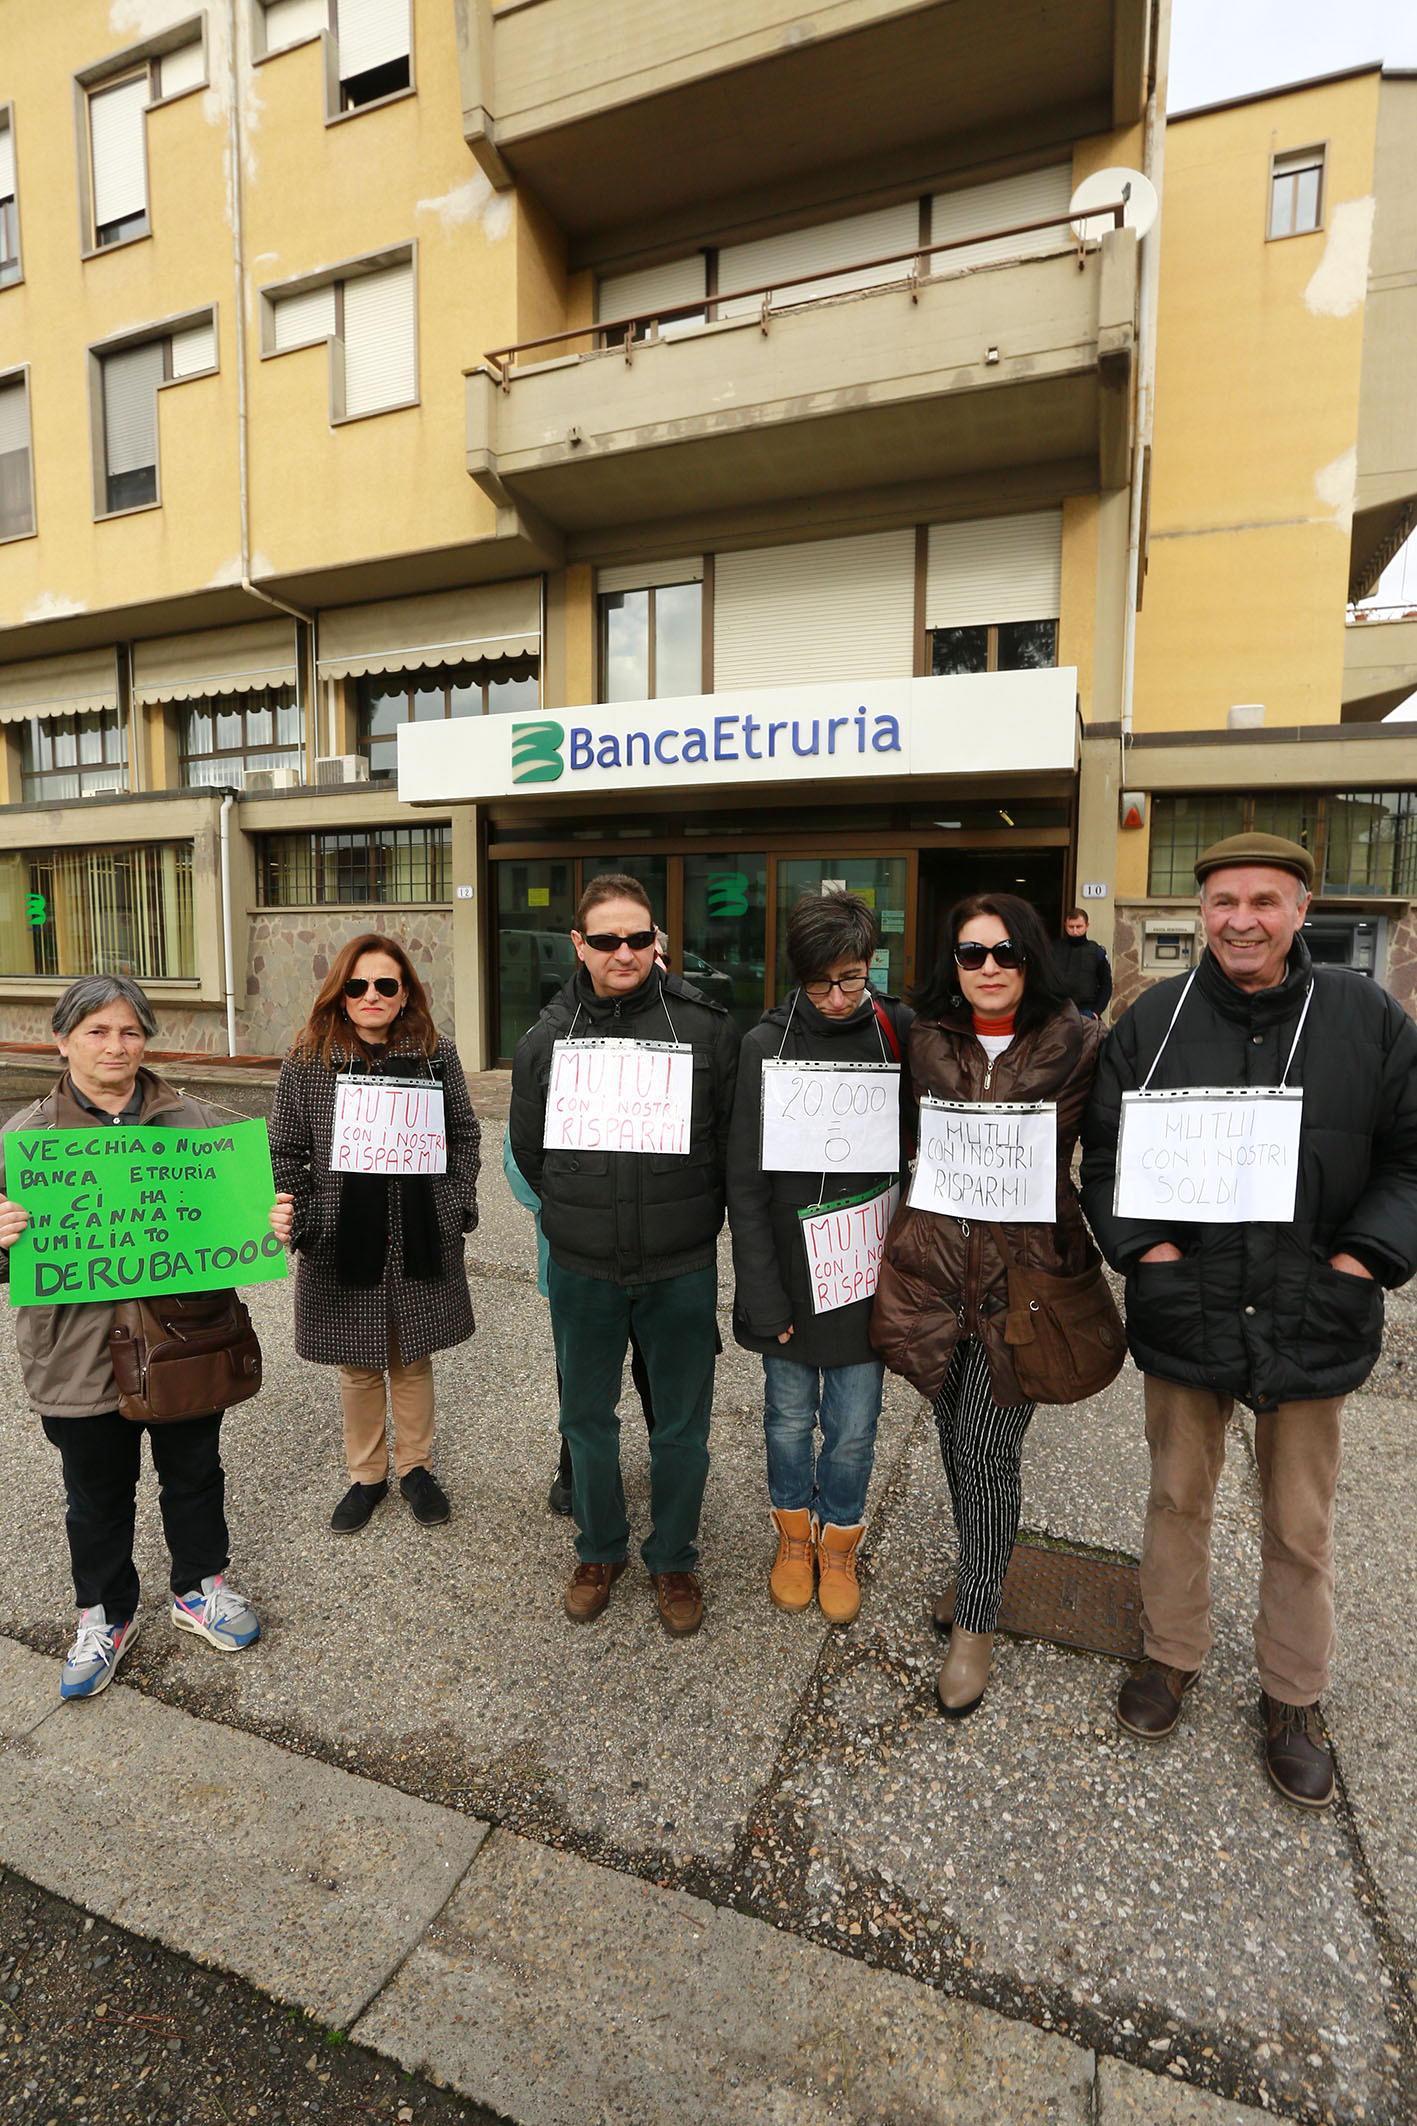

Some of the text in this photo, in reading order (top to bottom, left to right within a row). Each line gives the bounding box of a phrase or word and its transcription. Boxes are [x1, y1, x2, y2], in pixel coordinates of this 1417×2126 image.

[570, 705, 902, 770] BancaEtruria
[460, 888, 469, 897] 12
[1088, 885, 1102, 896] 10
[555, 1053, 671, 1097] MUTUI
[341, 1088, 429, 1128] MUTUI
[556, 1097, 590, 1112] CON
[618, 1098, 679, 1119] NOSTRI
[343, 1126, 371, 1142] CON
[397, 1130, 445, 1150] NOSTRI
[562, 1115, 685, 1152] RISPARMI
[947, 1121, 1020, 1146] MUTUI
[1165, 1109, 1255, 1141] MUTUI
[18, 1134, 144, 1162] VECCHIA
[176, 1138, 235, 1157] NUOVA
[339, 1144, 438, 1172] RISPARMI
[928, 1138, 954, 1162] CON
[971, 1145, 1033, 1169] NOSTRI
[1142, 1148, 1189, 1169] CON
[1217, 1144, 1286, 1166] NOSTRI
[20, 1166, 216, 1189] BANCA ETRURIA
[934, 1169, 1027, 1207] RISPARMI
[1156, 1176, 1238, 1204] SOLDI
[810, 1191, 890, 1258] MUTUI
[35, 1231, 284, 1297] DERUBATOOO
[815, 1259, 843, 1279] CON
